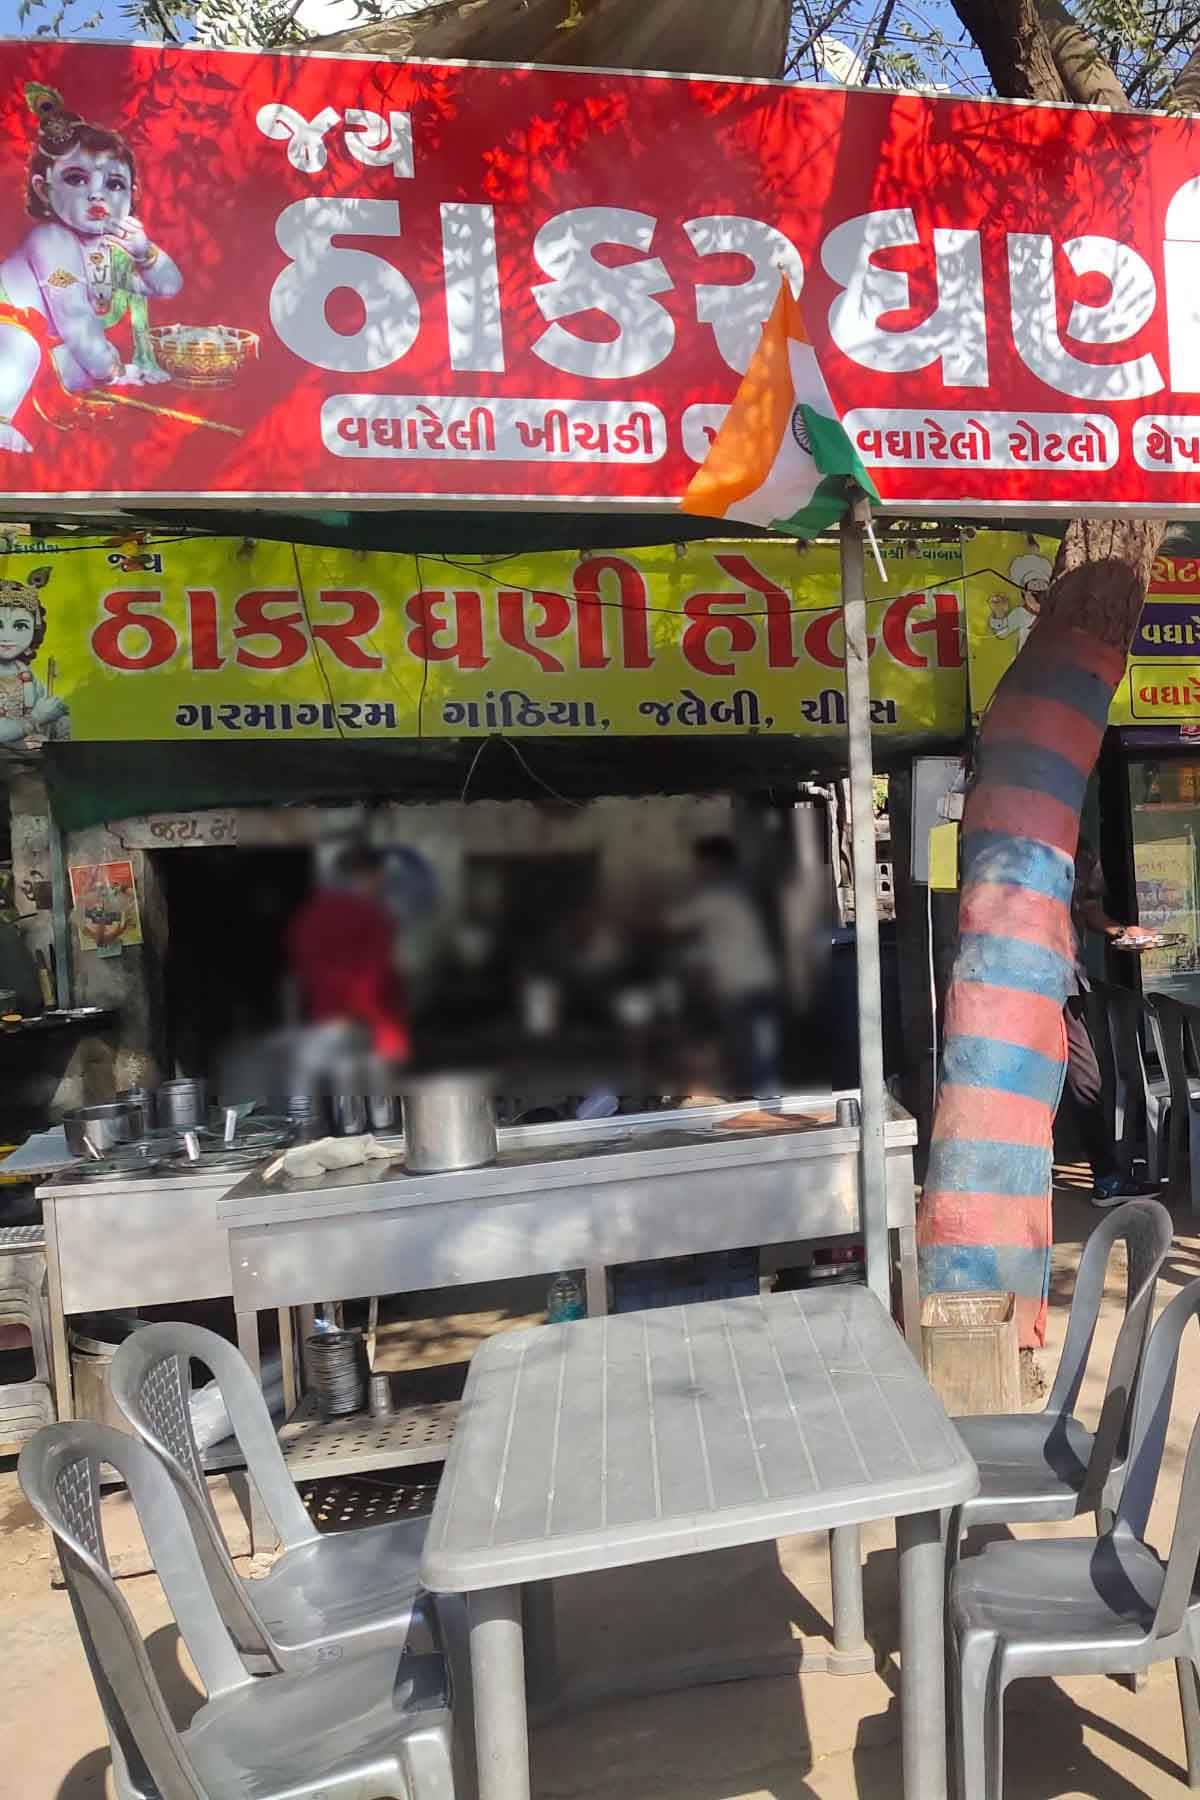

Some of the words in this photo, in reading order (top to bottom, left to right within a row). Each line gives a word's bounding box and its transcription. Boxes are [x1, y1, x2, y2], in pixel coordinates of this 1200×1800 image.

[256, 102, 415, 179] જય
[515, 408, 654, 455] ખીચડી
[1008, 419, 1108, 463] રોટલો
[91, 589, 384, 671] ઠાકર
[176, 701, 398, 731] ગરમાગરમ
[639, 689, 774, 729] જલેબી,
[800, 689, 897, 726] ચીસ
